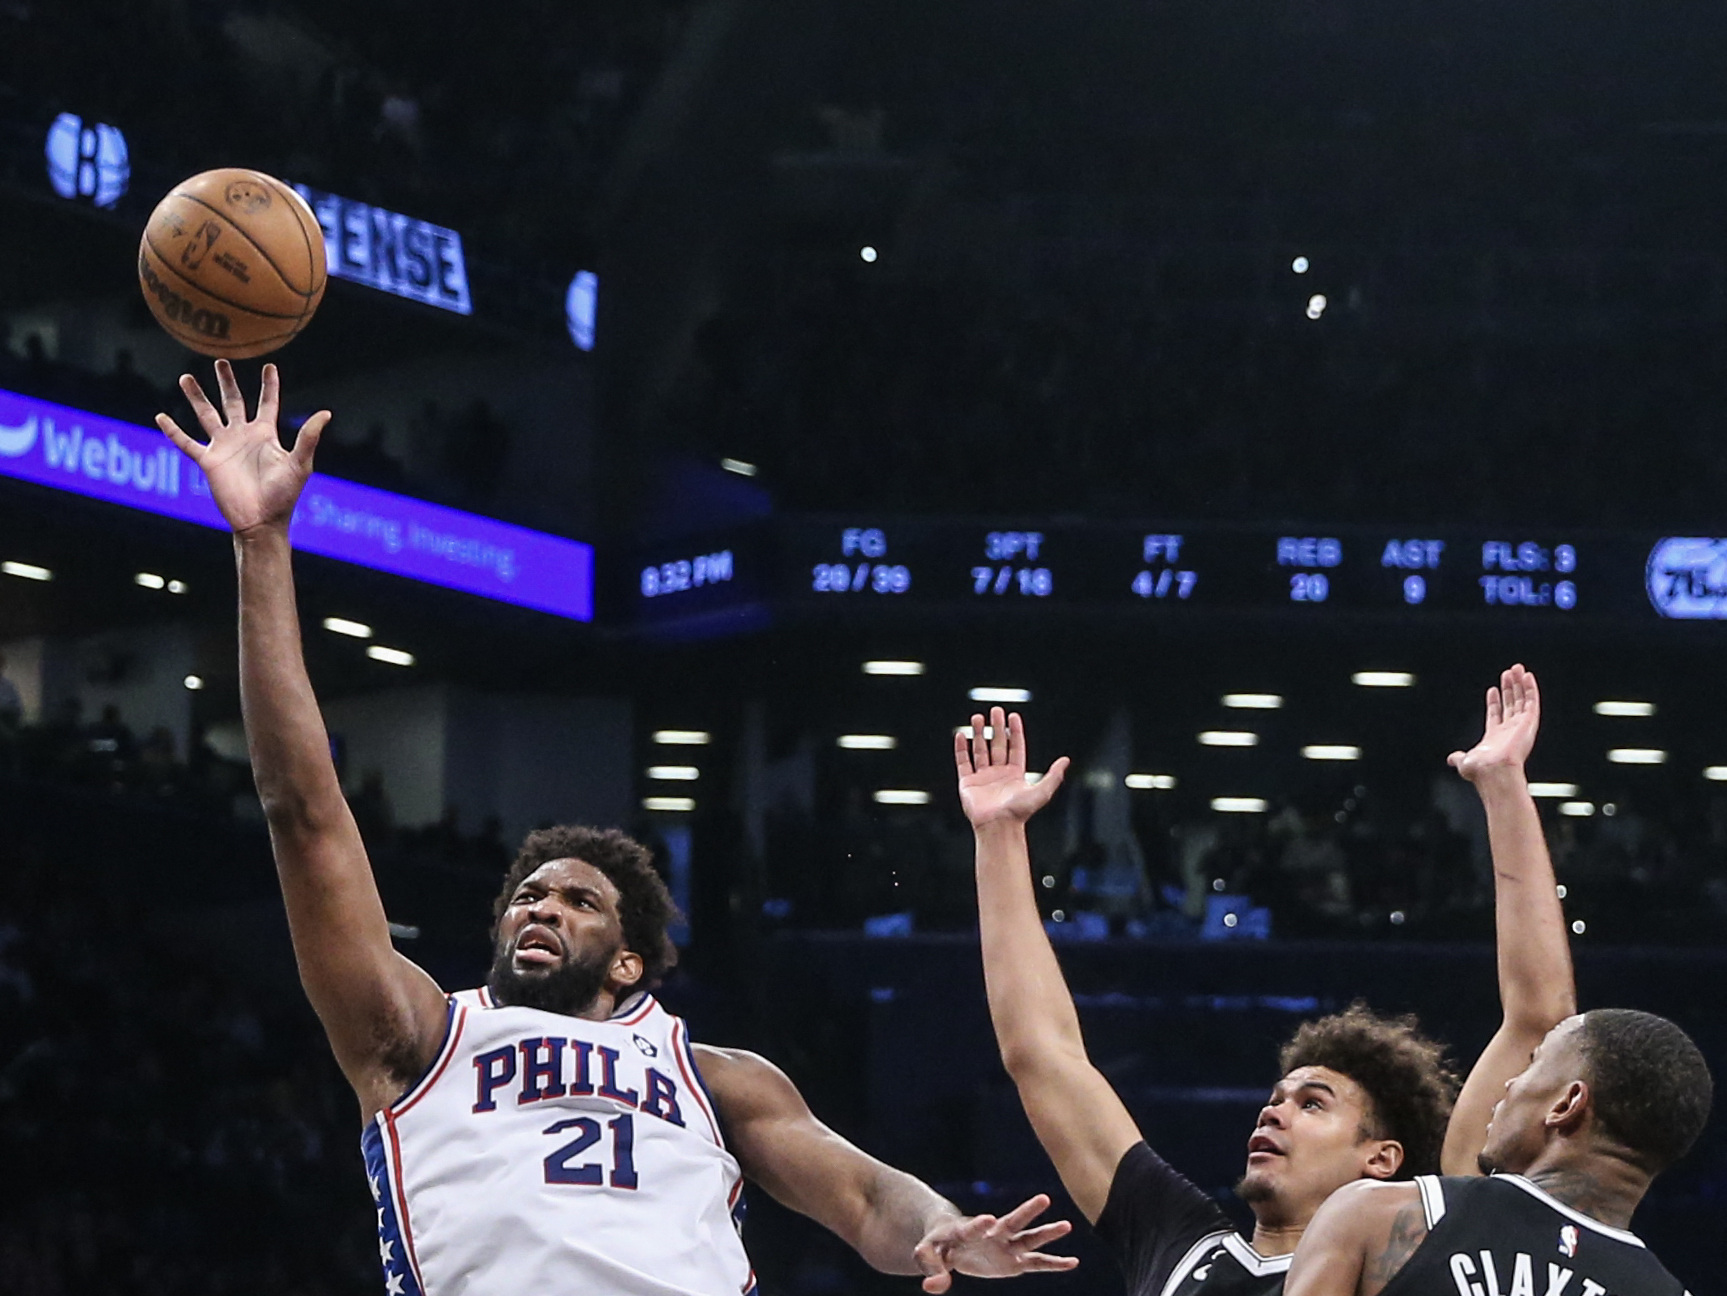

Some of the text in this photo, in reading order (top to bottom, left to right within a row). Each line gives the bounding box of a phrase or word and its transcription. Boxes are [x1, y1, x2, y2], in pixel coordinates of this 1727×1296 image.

[42, 416, 179, 498] Webull
[1143, 534, 1183, 563] FT
[1381, 538, 1445, 568] AST
[472, 1037, 686, 1128] PHILA
[543, 1113, 639, 1190] 21
